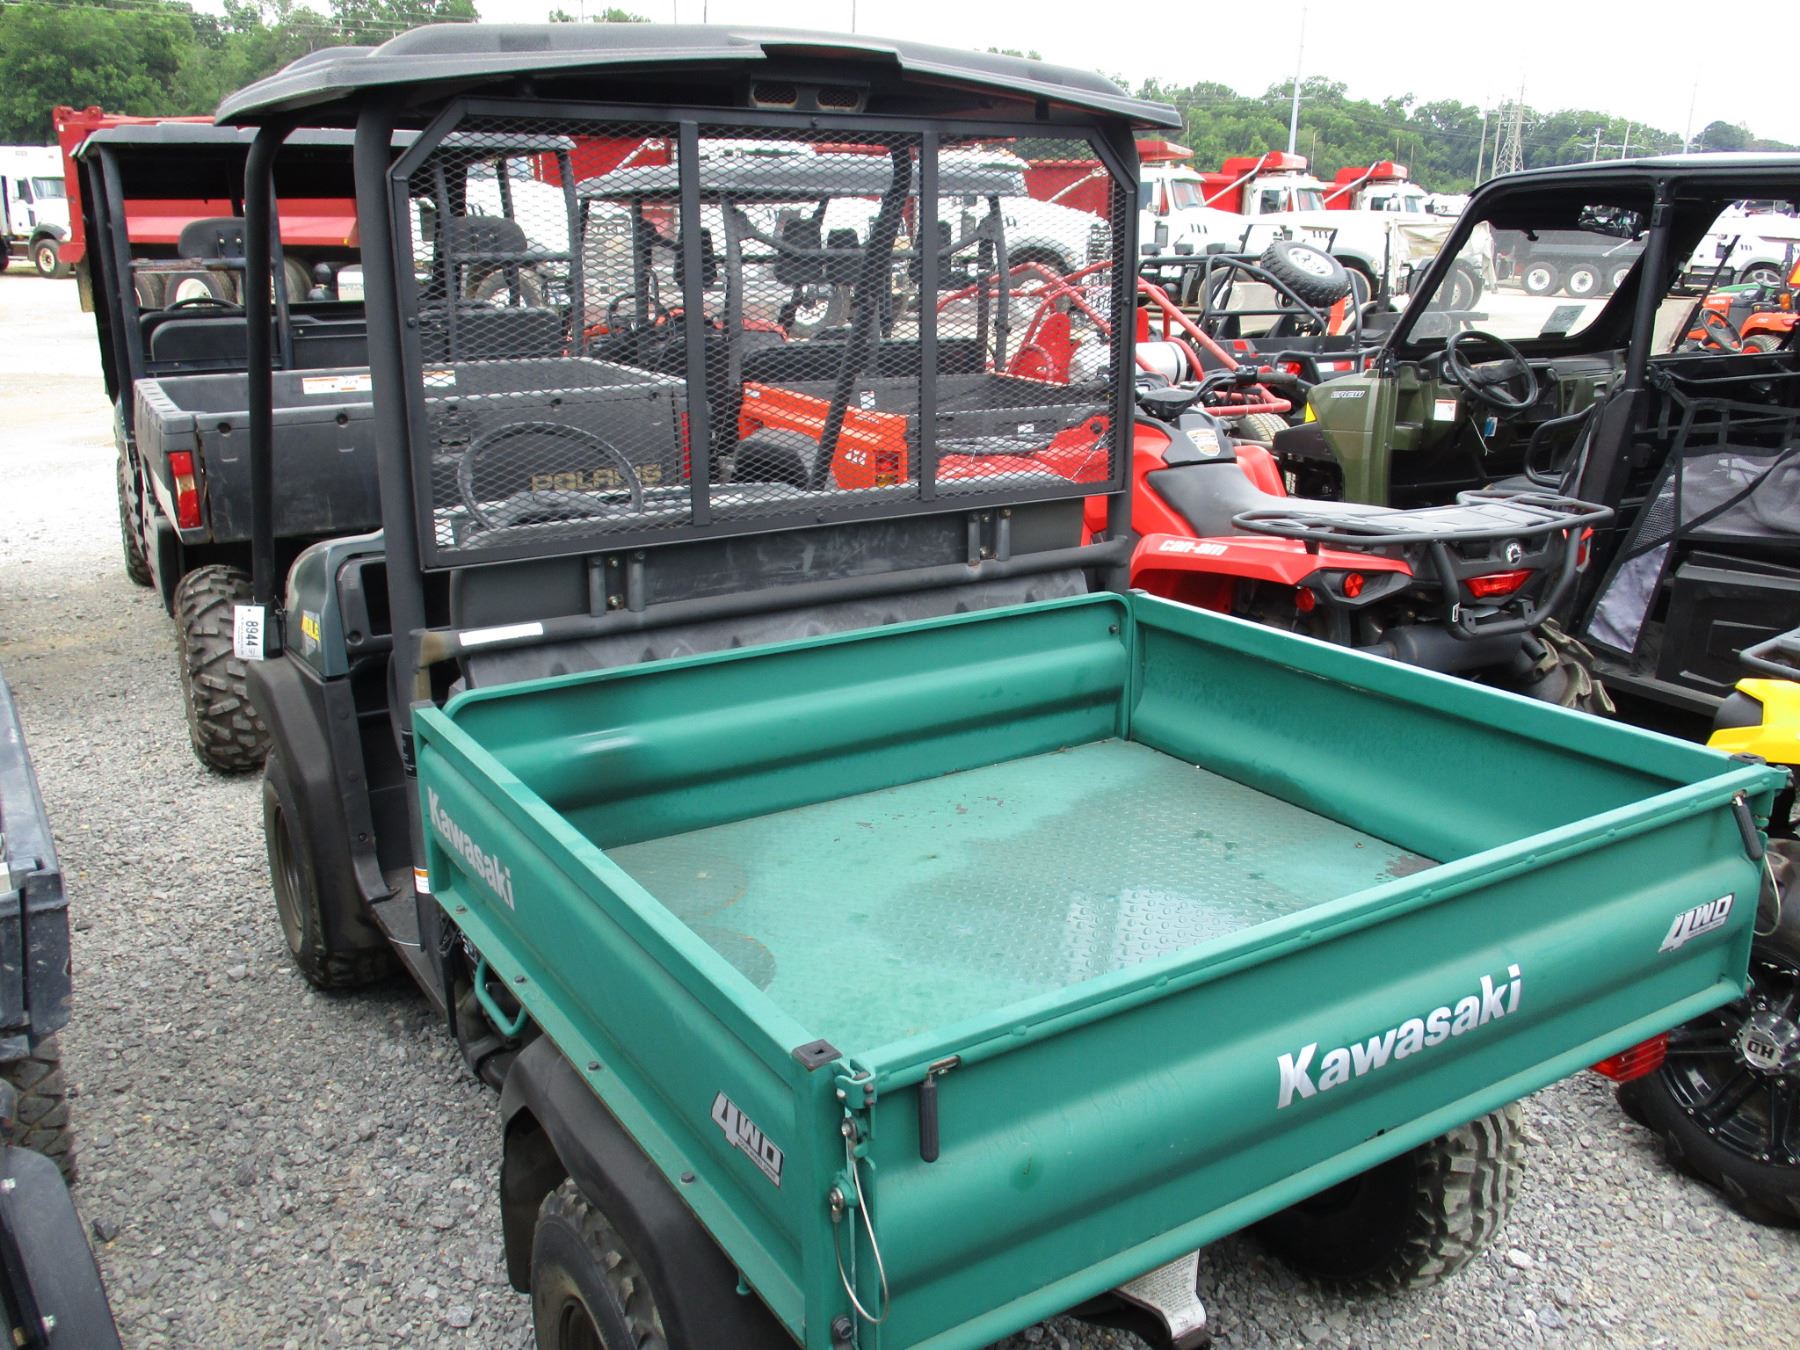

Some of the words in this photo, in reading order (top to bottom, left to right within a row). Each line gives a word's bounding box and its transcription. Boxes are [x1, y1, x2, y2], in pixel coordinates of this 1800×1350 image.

[245, 620, 259, 647] 8944
[427, 785, 515, 912] Kawasaki
[1658, 894, 1733, 953] 4WD
[1277, 963, 1521, 1110] Kawasaki
[711, 1091, 782, 1174] 4WD
